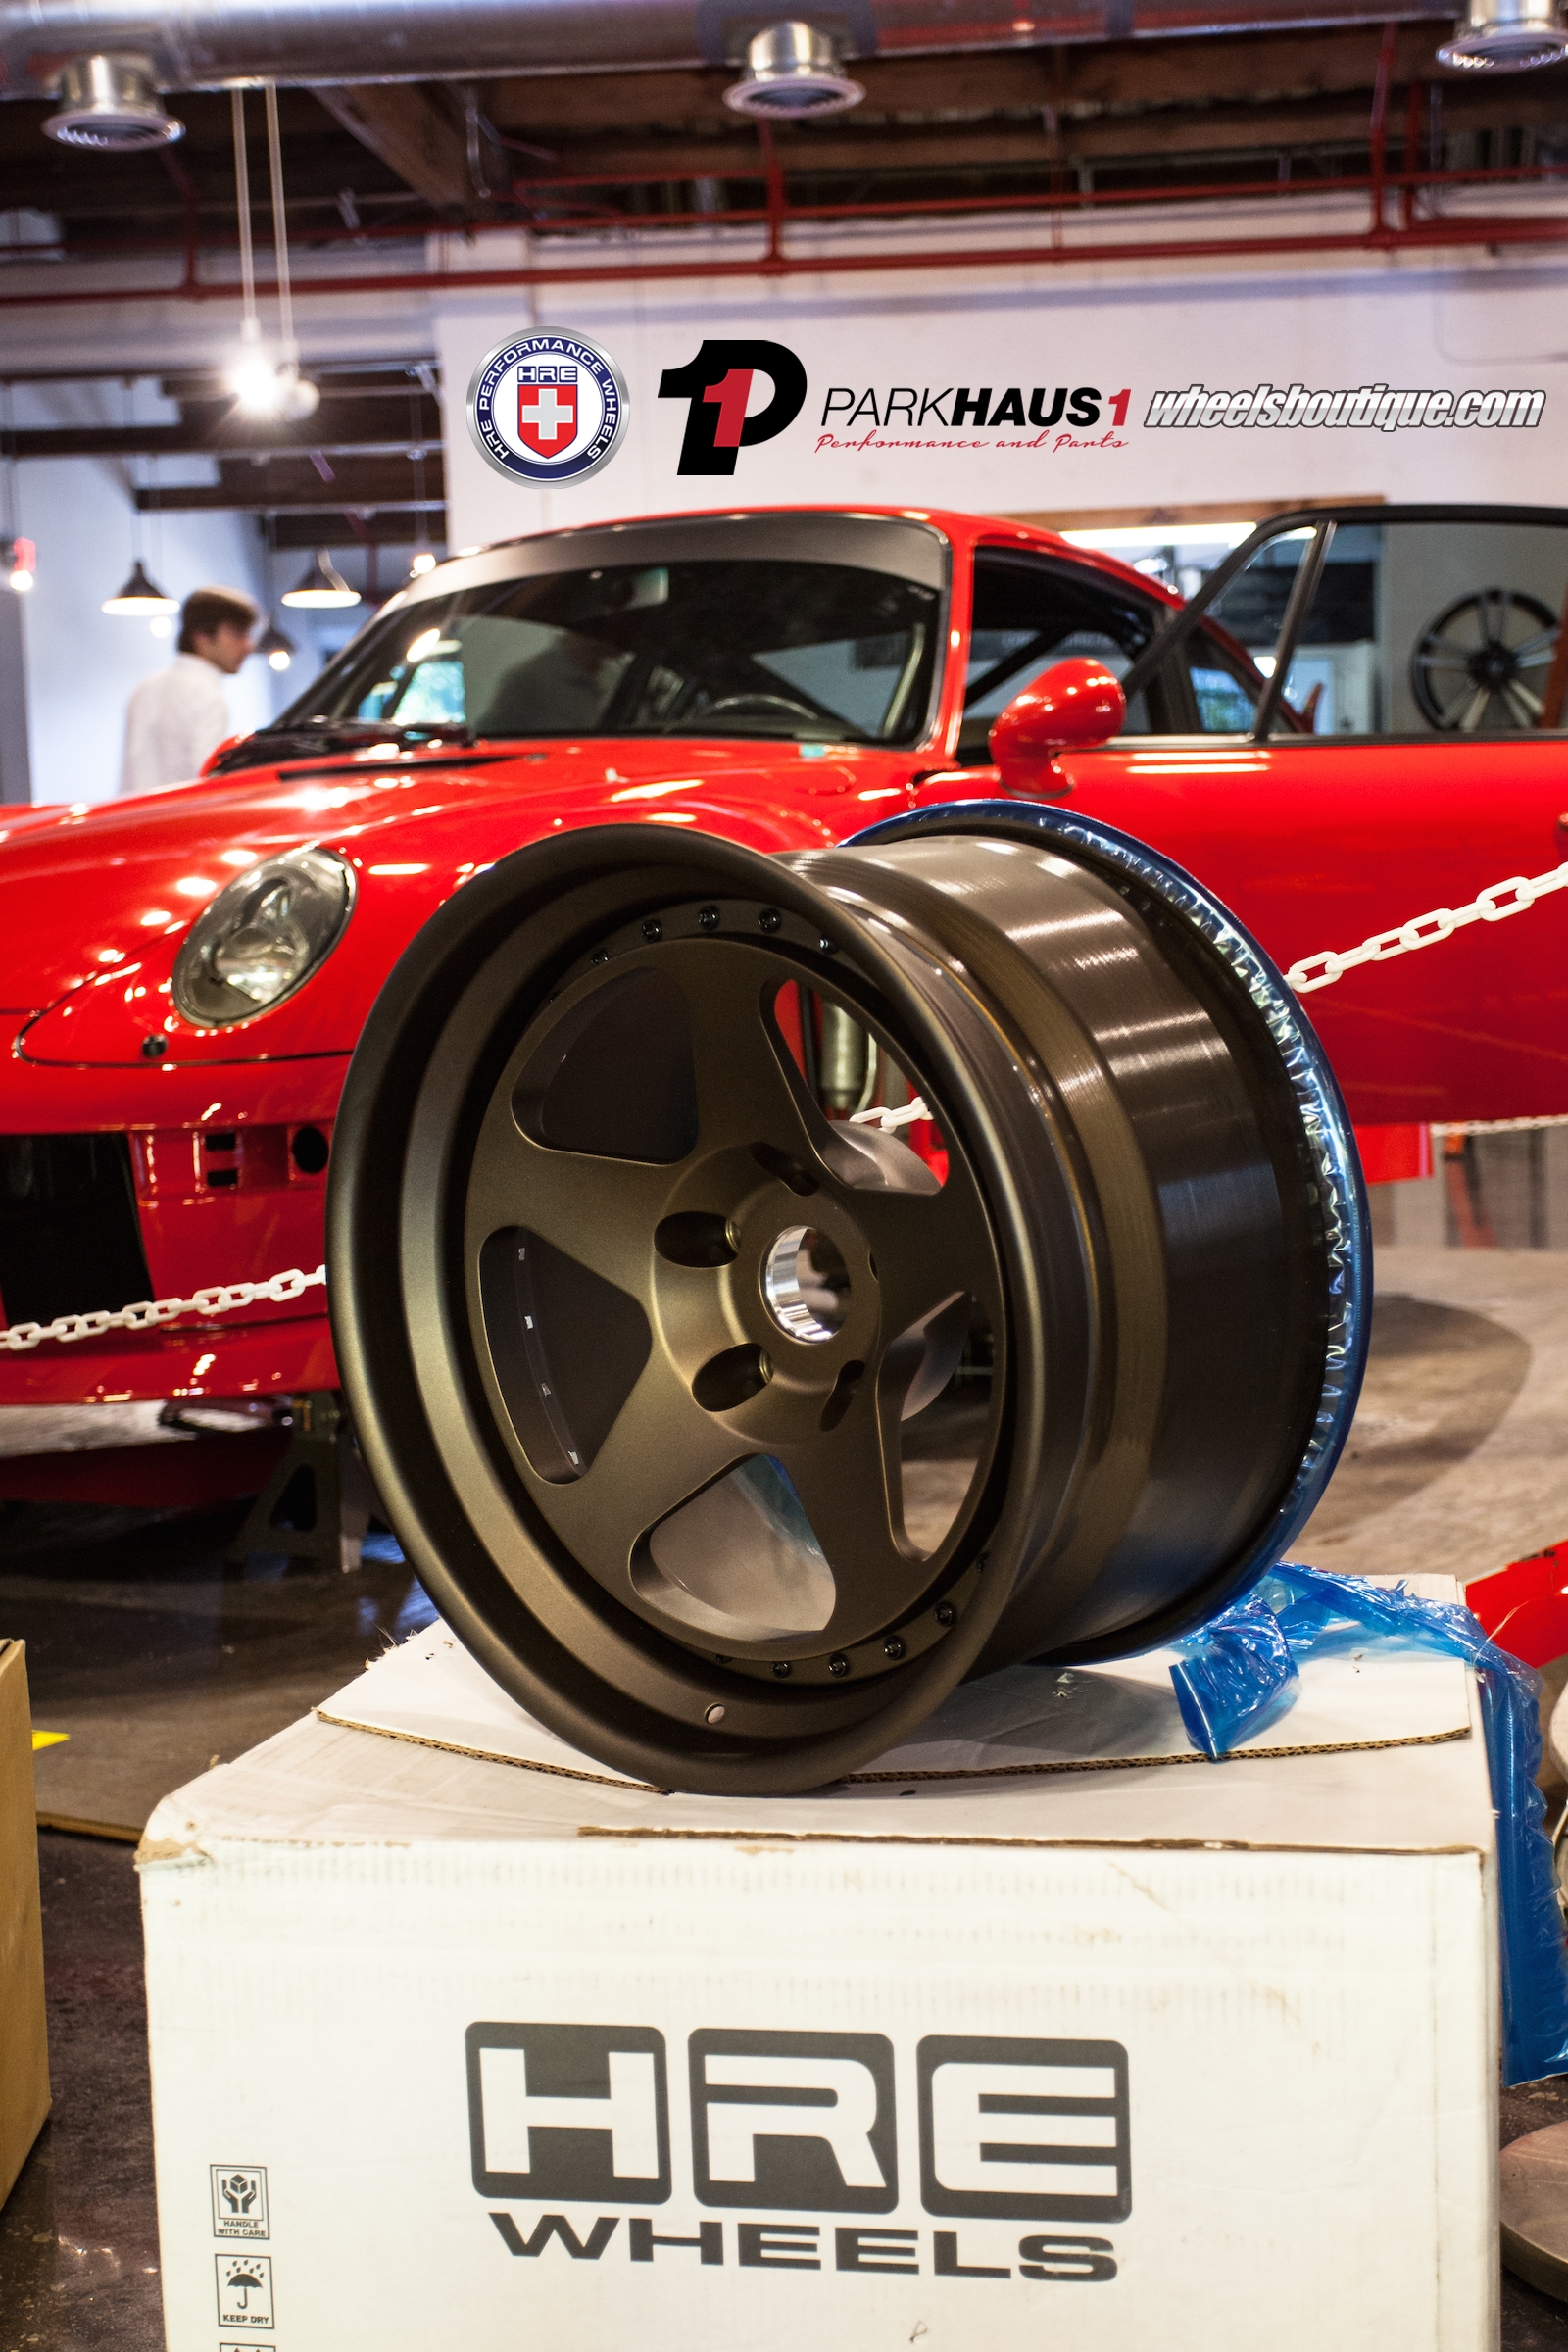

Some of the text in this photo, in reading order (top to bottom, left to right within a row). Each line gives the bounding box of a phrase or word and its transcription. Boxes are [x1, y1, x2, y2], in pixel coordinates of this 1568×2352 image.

[477, 2046, 1120, 2197] HRE
[242, 2229, 267, 2237] CARE
[488, 2212, 1118, 2281] WHEELS
[222, 2314, 248, 2323] KEEP
